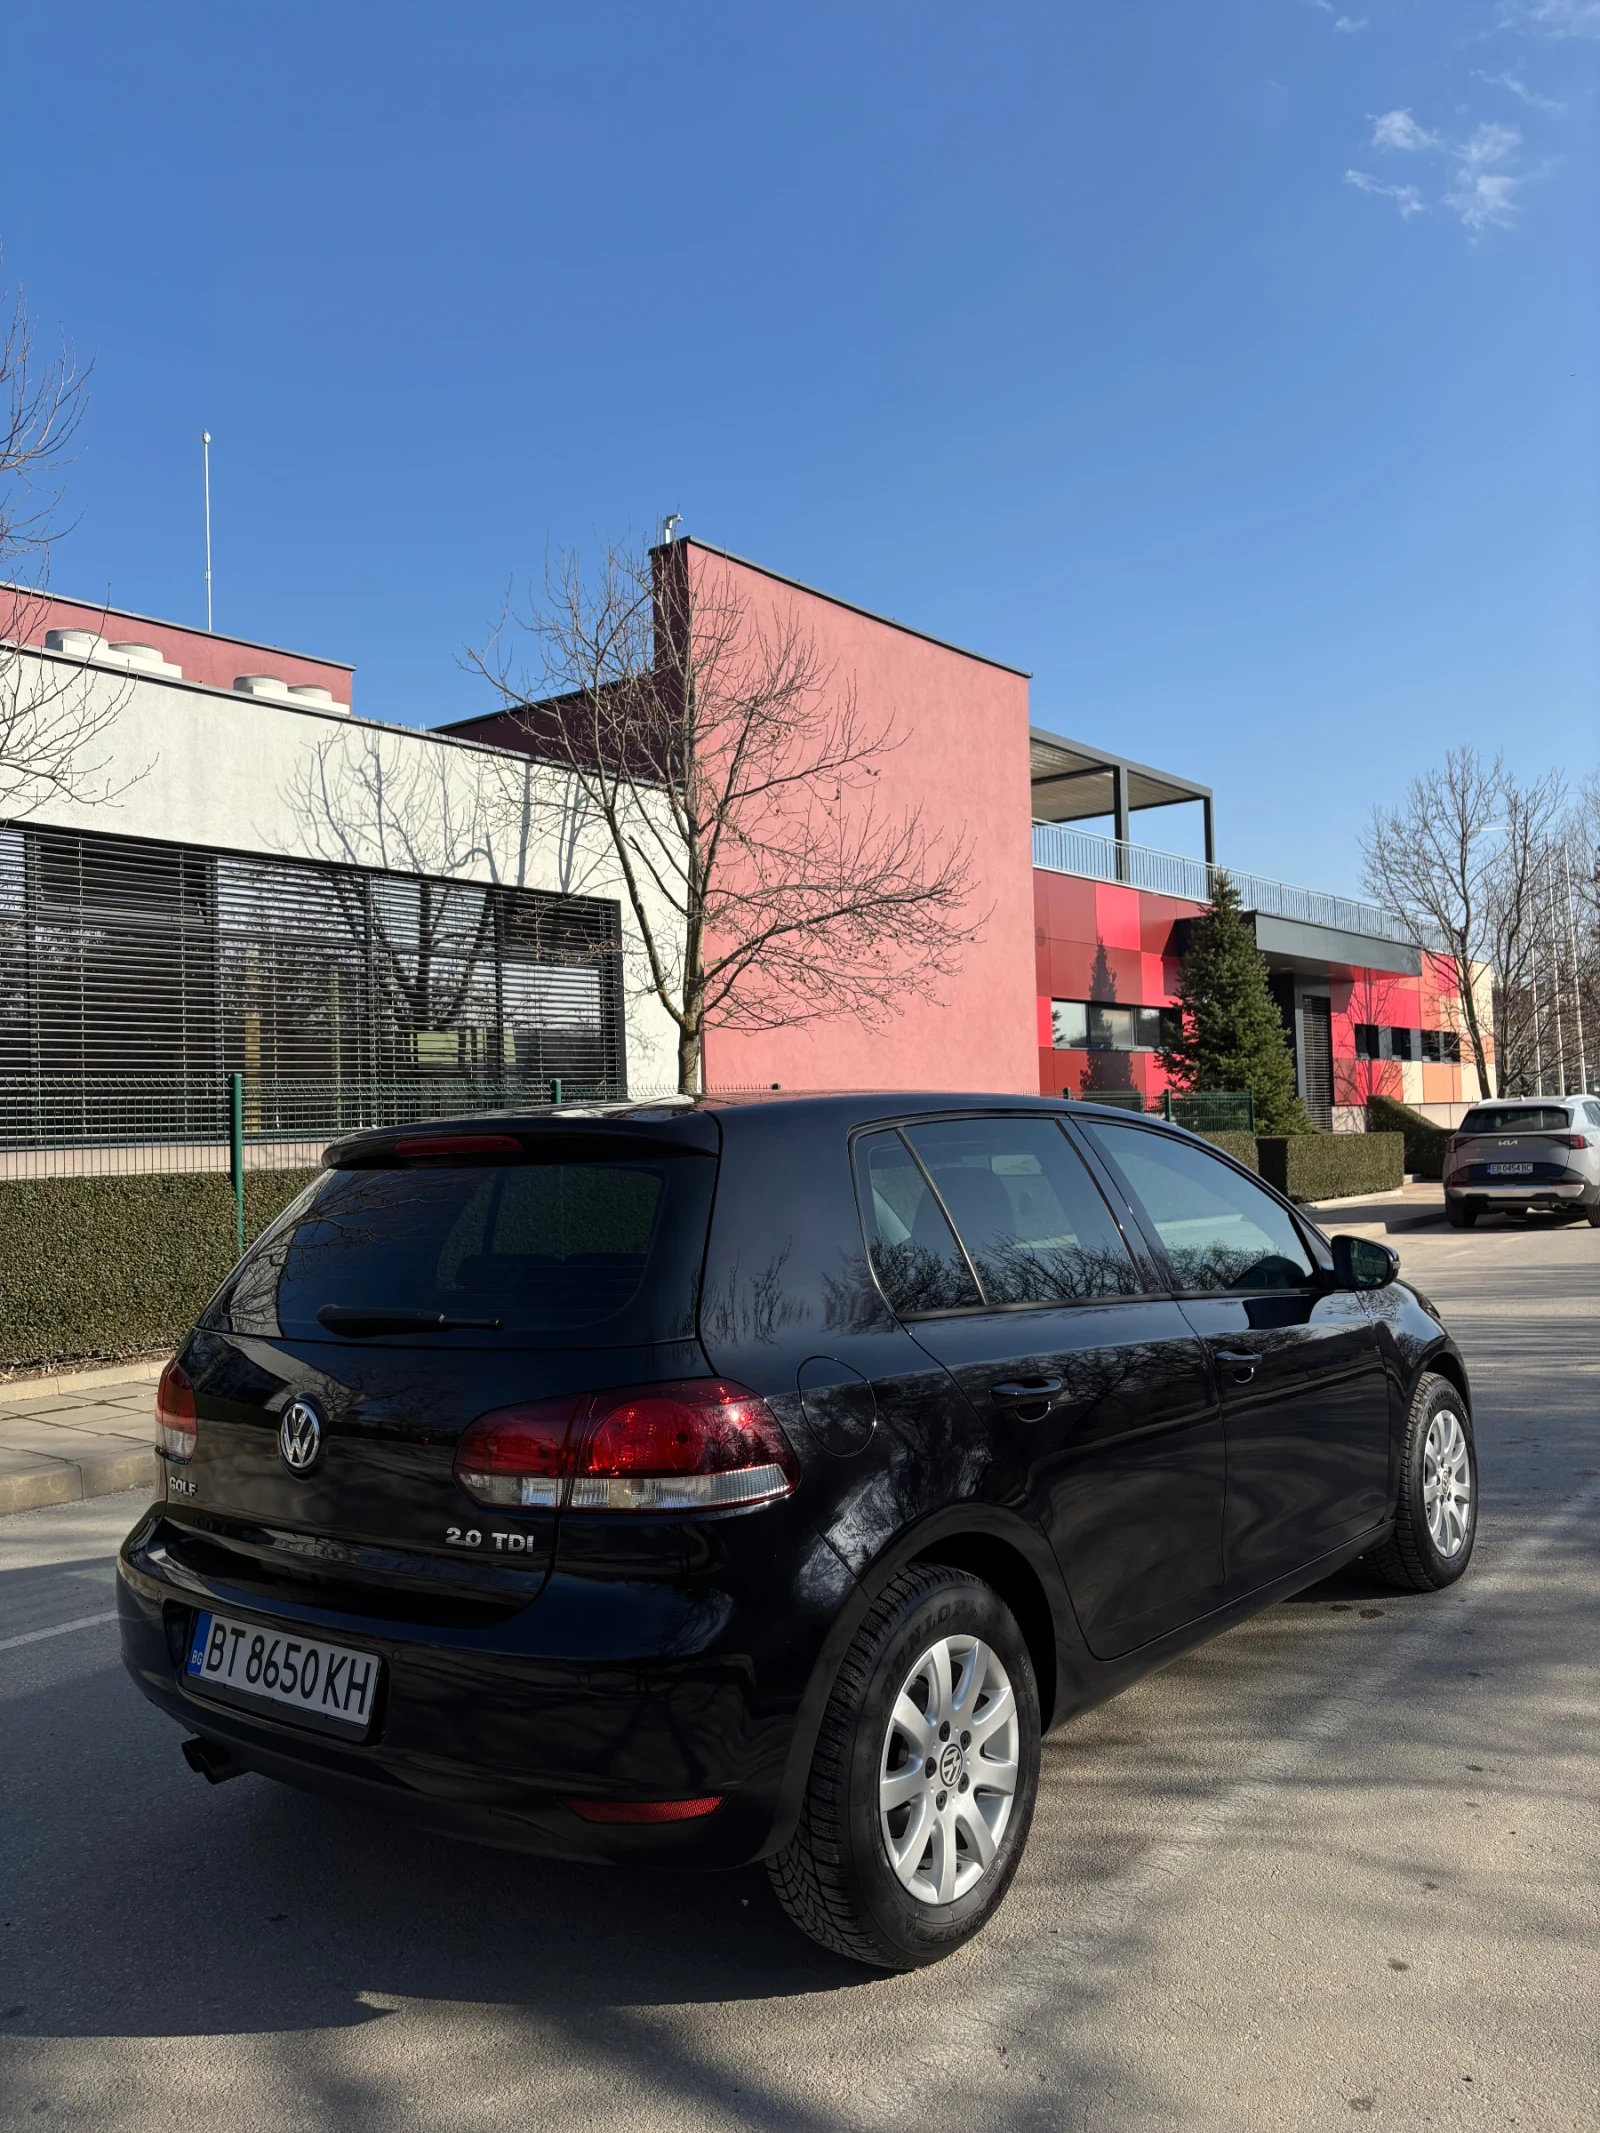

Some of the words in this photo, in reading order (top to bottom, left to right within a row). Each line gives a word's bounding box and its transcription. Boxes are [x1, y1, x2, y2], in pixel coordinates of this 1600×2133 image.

[1502, 1164, 1521, 1173] 0454
[1521, 1164, 1532, 1172] BC
[169, 1476, 198, 1497] GOLF
[445, 1526, 482, 1548] 2.0
[491, 1532, 534, 1553] TDI
[191, 1649, 203, 1665] BG
[879, 1599, 967, 1705] DUNLOP
[205, 1622, 246, 1677] BT
[245, 1634, 319, 1699] 8650
[321, 1652, 372, 1715] KH
